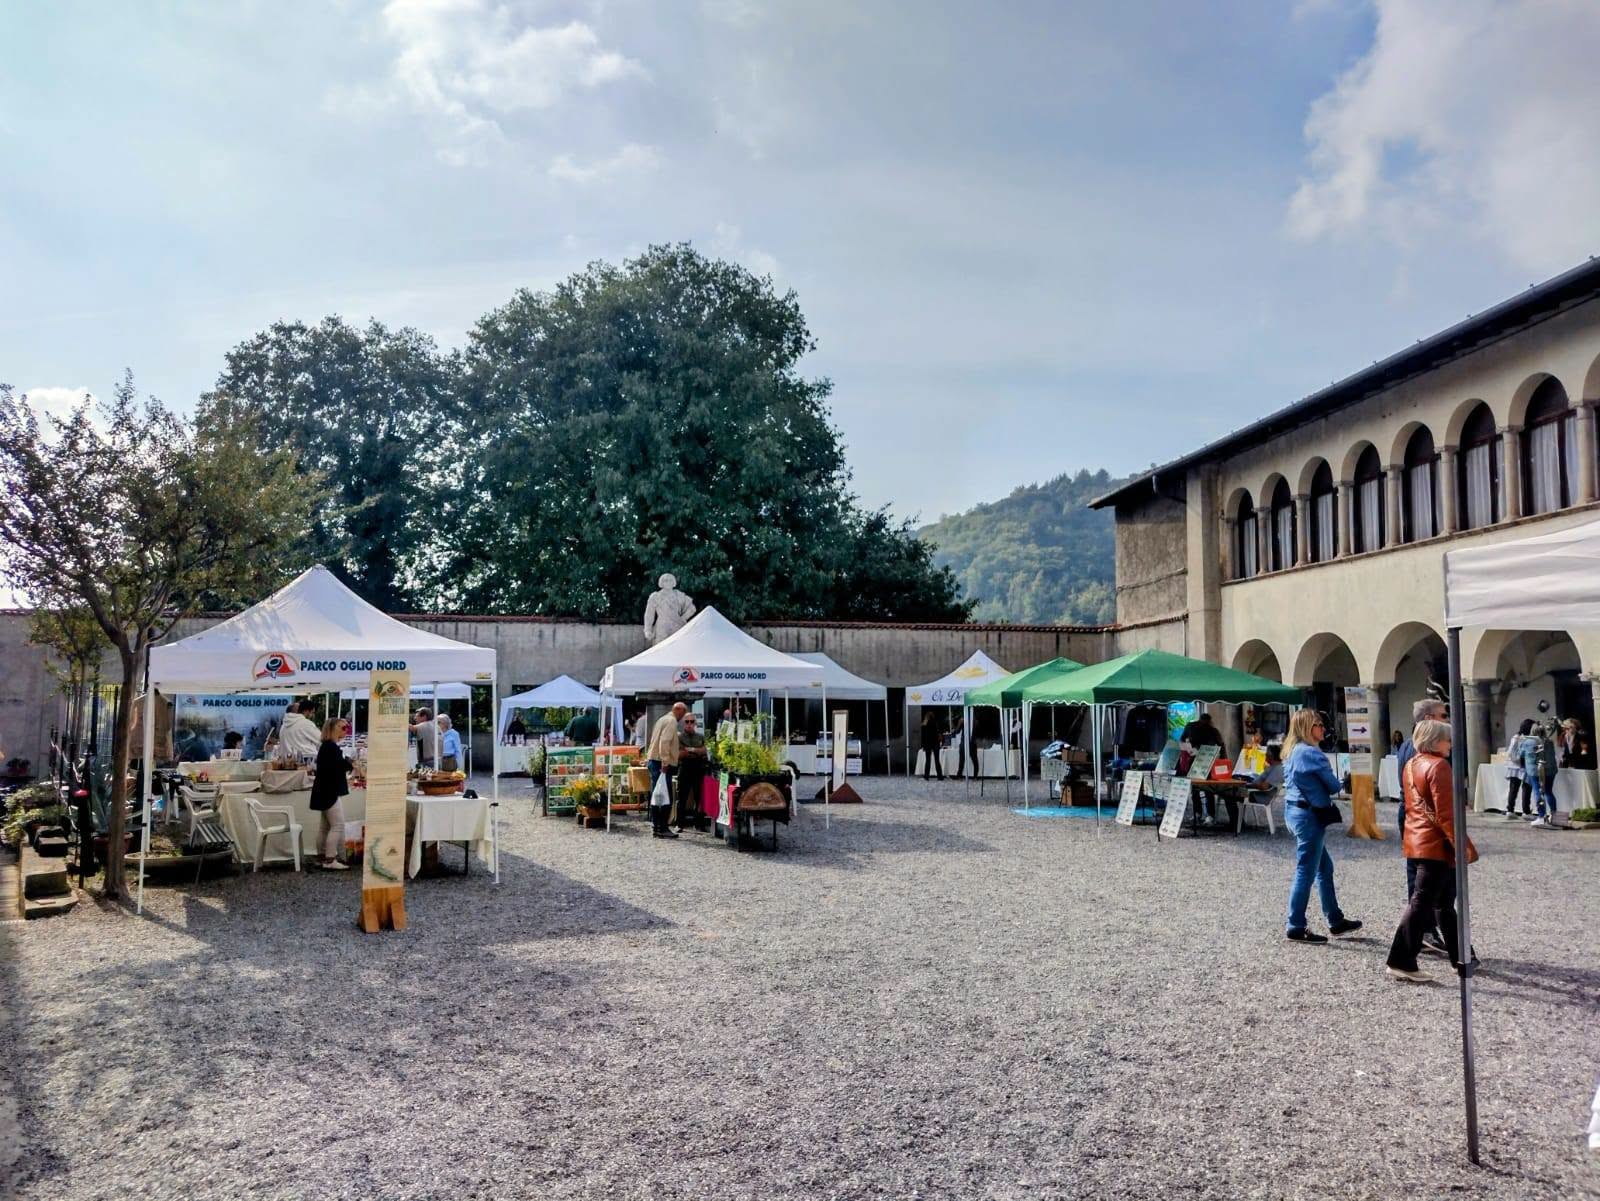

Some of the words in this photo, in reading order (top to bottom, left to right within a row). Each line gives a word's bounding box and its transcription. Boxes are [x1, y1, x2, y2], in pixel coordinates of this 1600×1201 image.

[300, 661, 337, 671] PARCO
[340, 661, 373, 671] OGLIO
[377, 661, 407, 671] NORD
[700, 672, 723, 680] PARCO
[724, 672, 746, 680] OGLIO
[747, 672, 767, 680] NORD
[202, 699, 233, 707] PARCO
[234, 699, 262, 707] OGLIO
[263, 698, 289, 707] NORD
